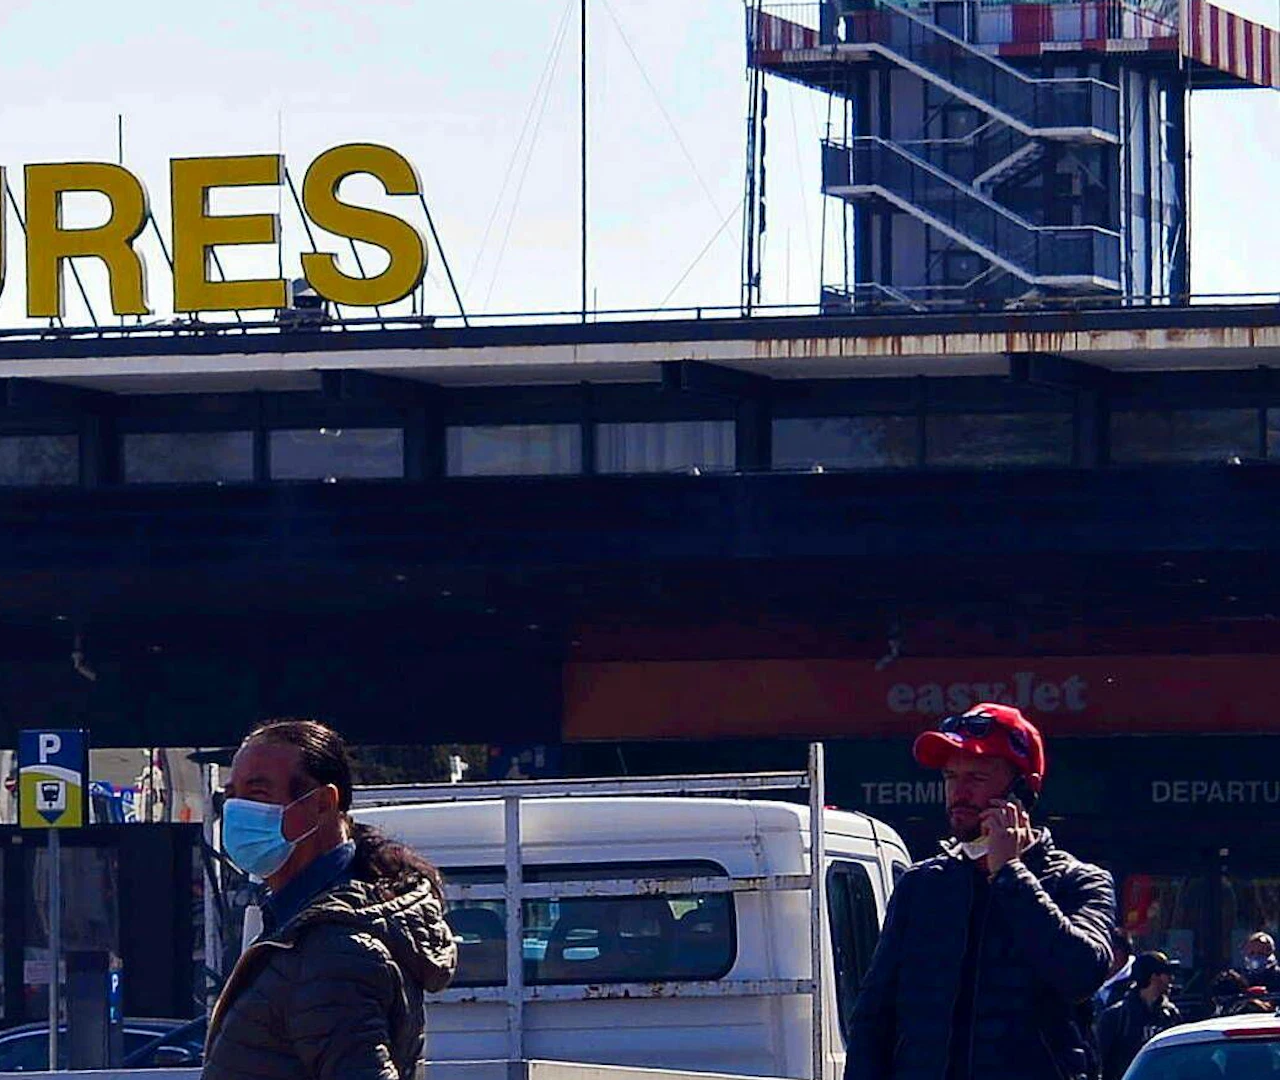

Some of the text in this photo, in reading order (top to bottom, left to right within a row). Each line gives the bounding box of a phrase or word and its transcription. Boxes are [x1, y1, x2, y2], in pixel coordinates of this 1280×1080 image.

[887, 672, 1088, 713] easyJet
[39, 734, 62, 764] P
[860, 780, 1280, 804] TERMI DEPARTU
